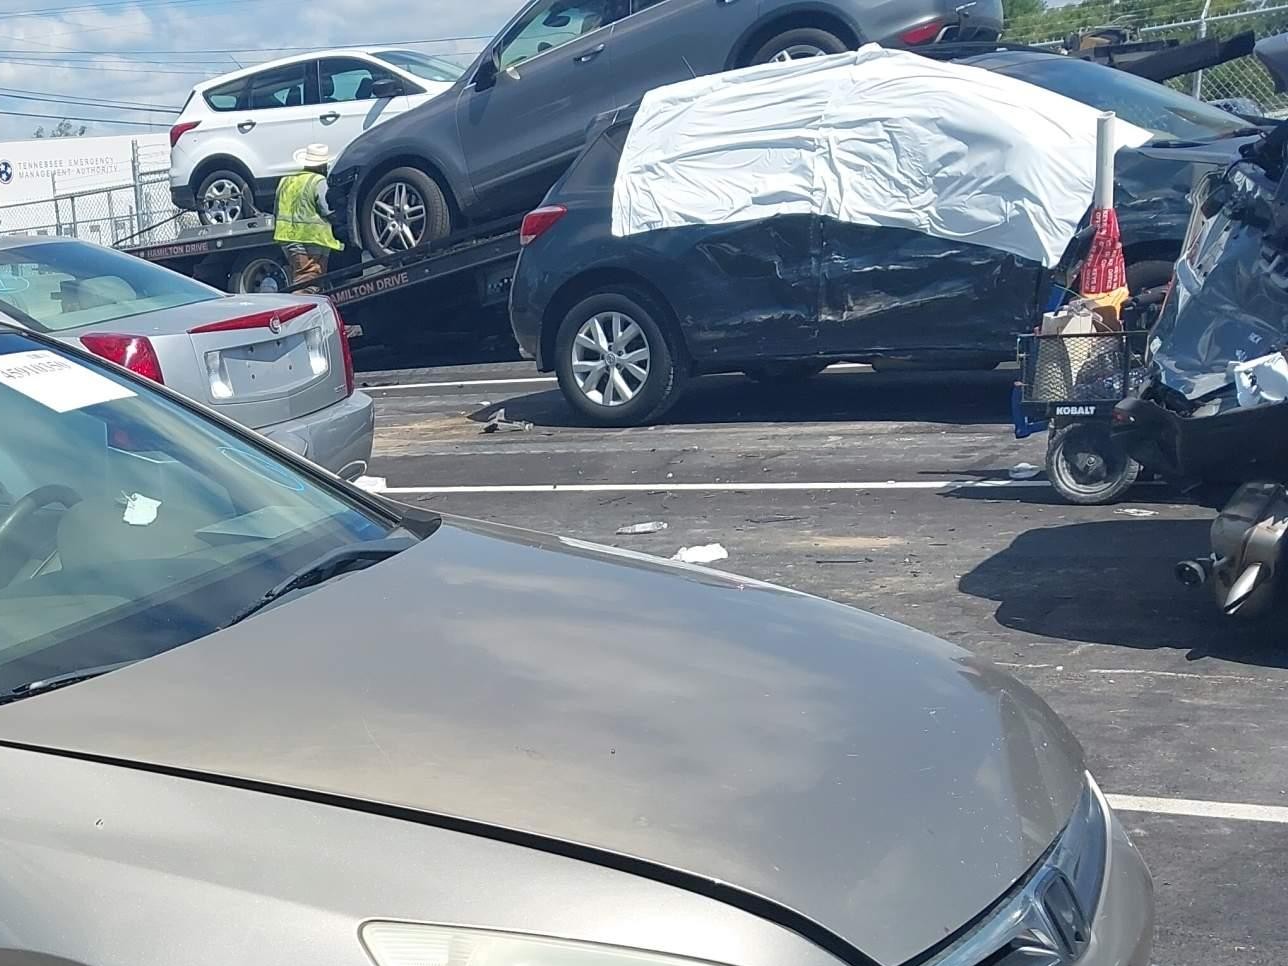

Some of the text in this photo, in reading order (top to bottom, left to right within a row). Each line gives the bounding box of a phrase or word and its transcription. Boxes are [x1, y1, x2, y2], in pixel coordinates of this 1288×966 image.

[18, 156, 114, 169] TENNESSEE EMERGENCY
[18, 165, 118, 179] MANAGEMENT AUTHORITY
[147, 242, 208, 258] HAMILTON DRIVE
[330, 272, 409, 304] AMILTON DRIVE
[0, 361, 72, 379] 45910350
[1056, 406, 1096, 415] KOBALT
